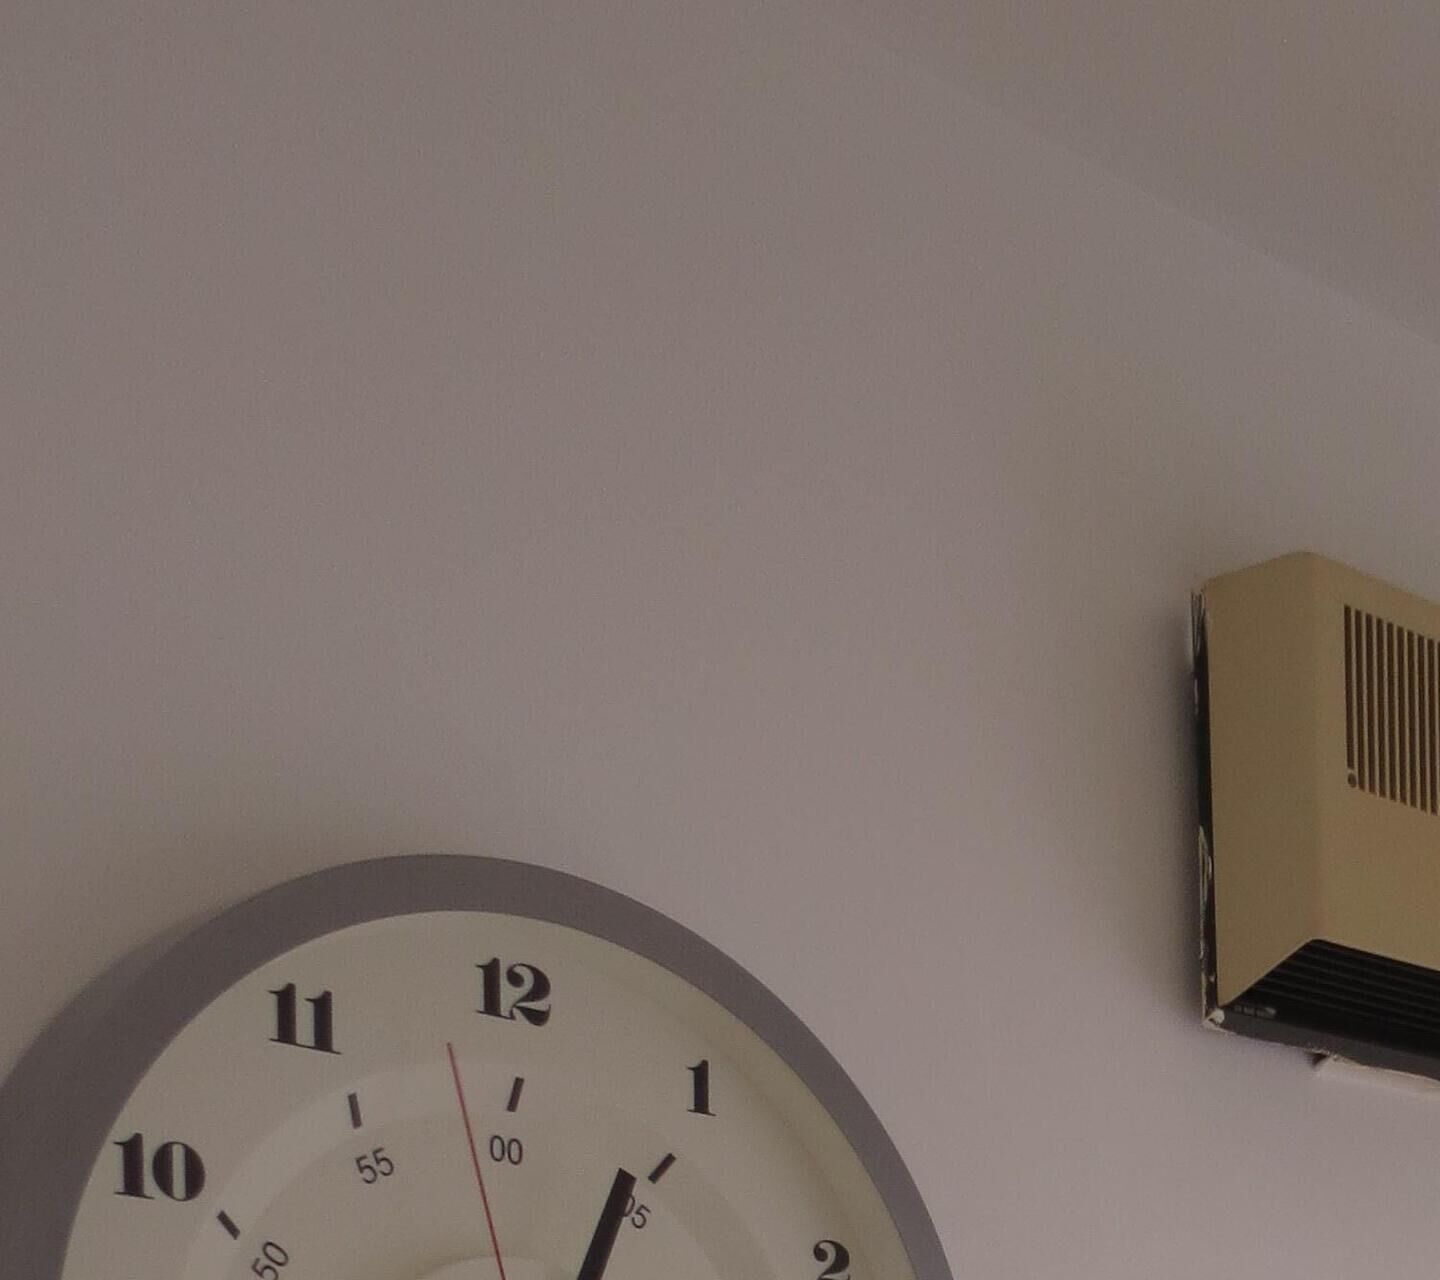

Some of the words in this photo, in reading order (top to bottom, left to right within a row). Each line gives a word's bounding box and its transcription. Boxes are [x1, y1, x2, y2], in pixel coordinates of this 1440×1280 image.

[269, 983, 340, 1054] 11
[477, 958, 550, 1026] 12
[688, 1060, 715, 1116] 1
[112, 1132, 205, 1203] 10
[356, 1148, 393, 1184] 55
[490, 1135, 522, 1165] 00
